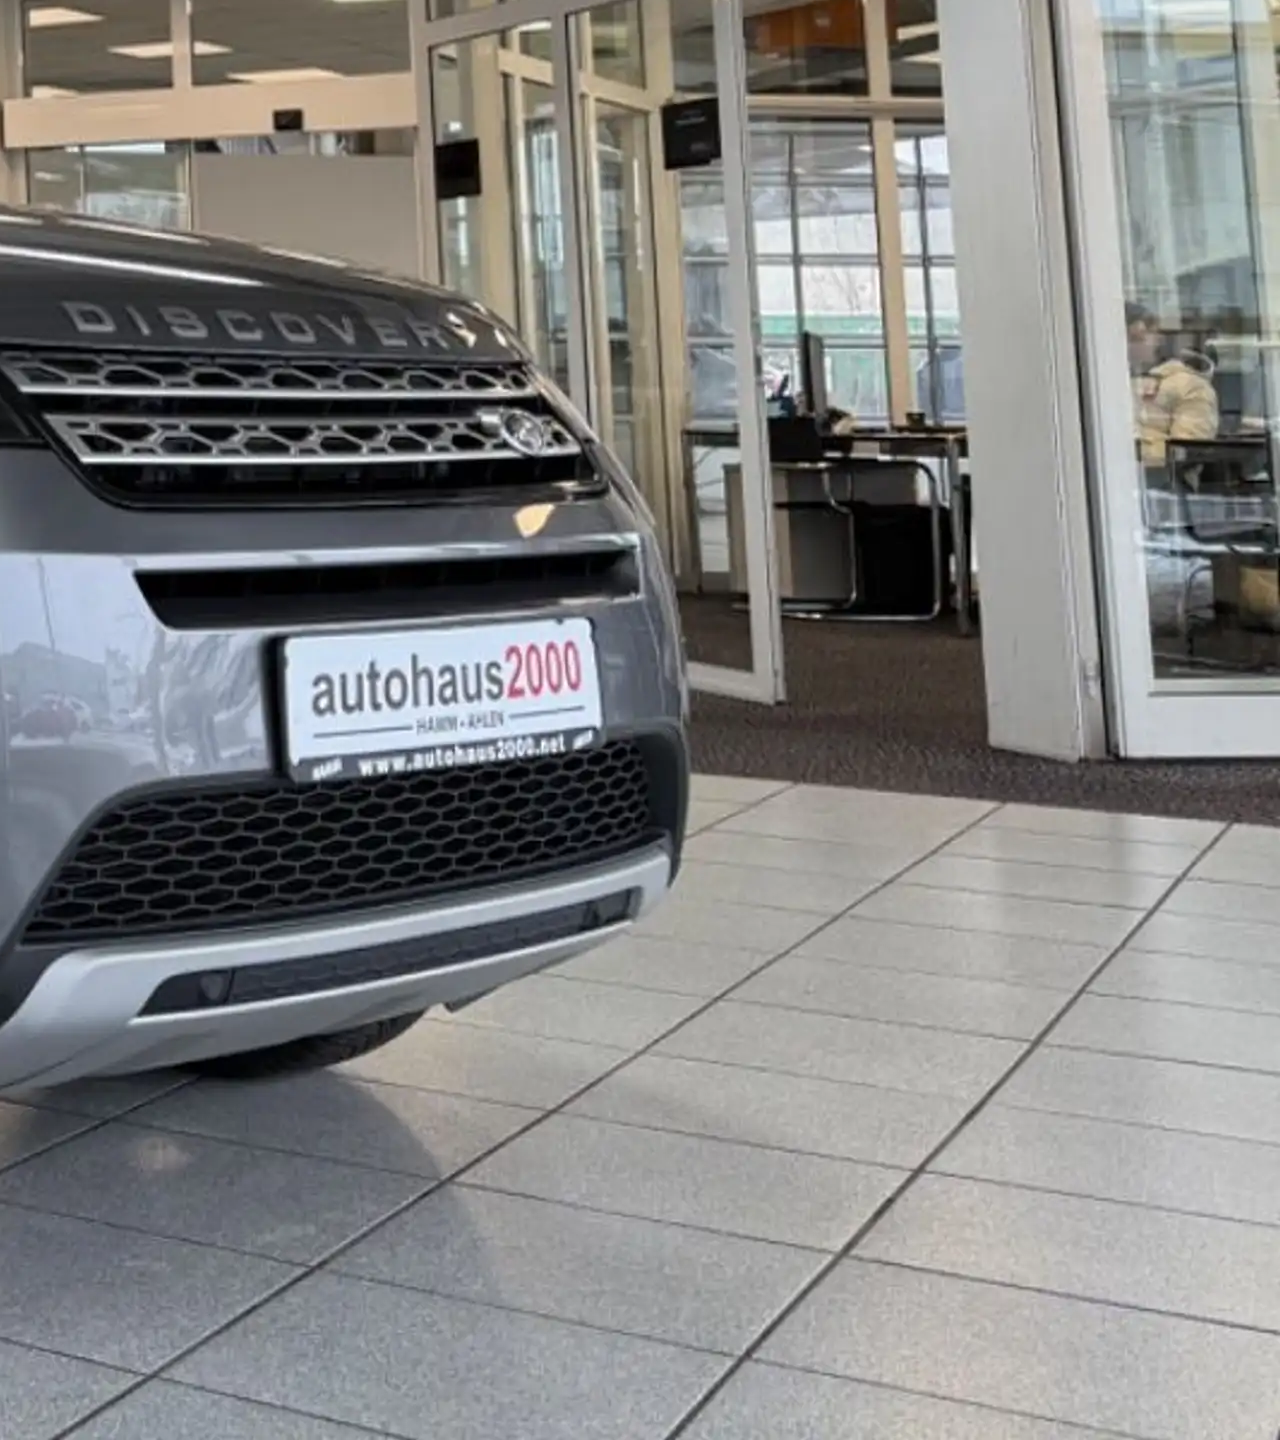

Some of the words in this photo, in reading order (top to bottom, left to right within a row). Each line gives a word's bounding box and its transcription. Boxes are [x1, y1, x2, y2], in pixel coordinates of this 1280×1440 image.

[60, 300, 477, 349] DISCOVERY
[311, 639, 583, 717] autohaus2000
[358, 734, 567, 777] www.autohaus2000.net
